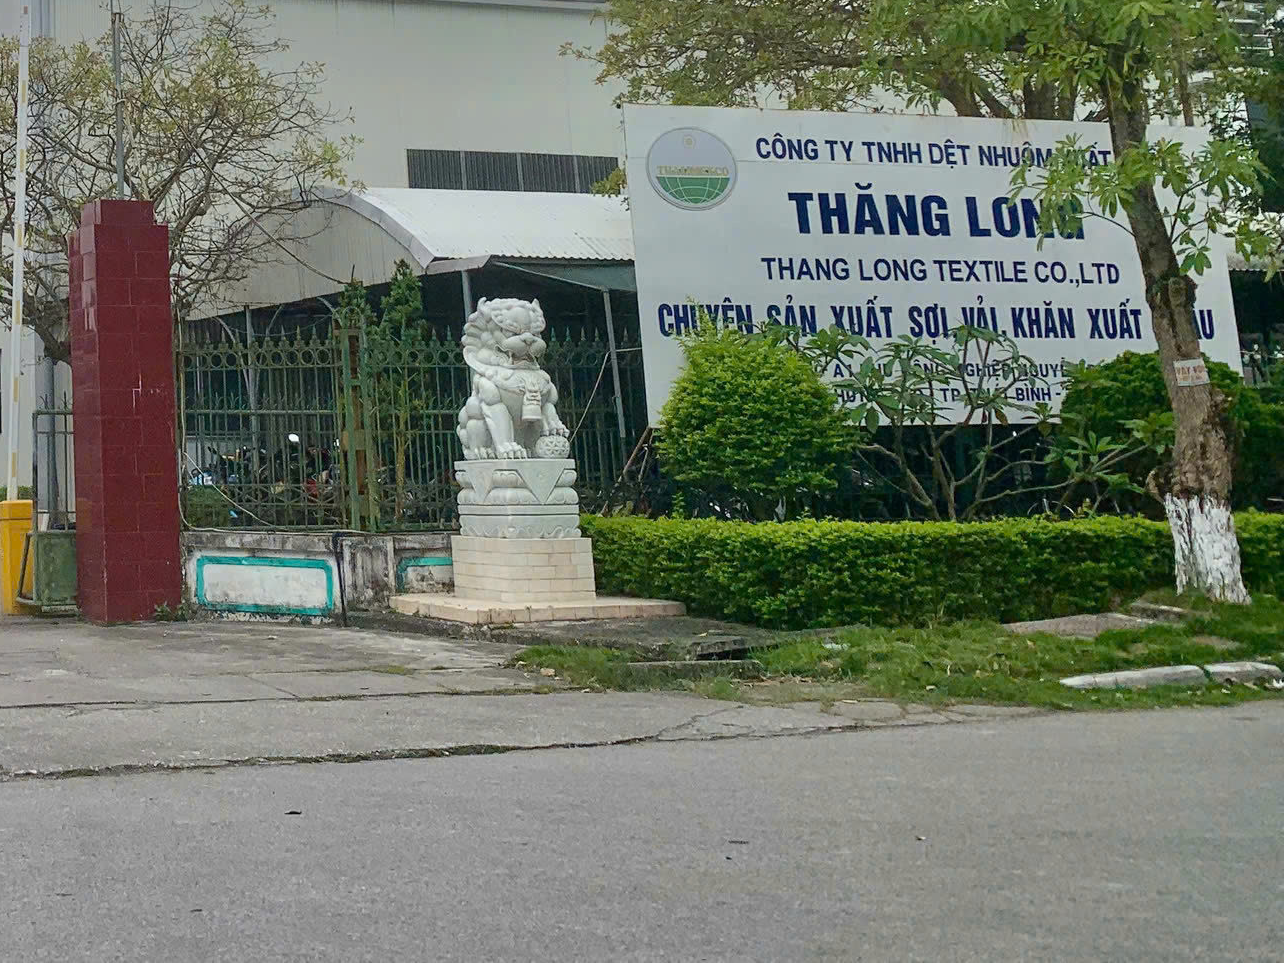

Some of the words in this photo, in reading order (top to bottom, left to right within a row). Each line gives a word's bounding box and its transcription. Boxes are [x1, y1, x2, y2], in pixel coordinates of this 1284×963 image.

[756, 133, 819, 160] CÔNG
[825, 140, 853, 161] TY
[862, 142, 922, 163] TNHH
[928, 139, 970, 169] DỆT
[978, 141, 1052, 172] NHUỘM
[788, 183, 951, 236] THĂNG
[761, 257, 850, 281] THANG
[859, 259, 927, 281] LONG
[933, 260, 1028, 283] TEXTILE
[1034, 261, 1119, 287] CO.,LTD
[658, 297, 753, 337] CHUYÊN
[766, 294, 817, 337] SẢN
[831, 295, 893, 338] XUẤT
[1011, 300, 1076, 339] KHĂN
[1087, 298, 1142, 340] XUẤT
[1015, 383, 1052, 401] BÌNH
